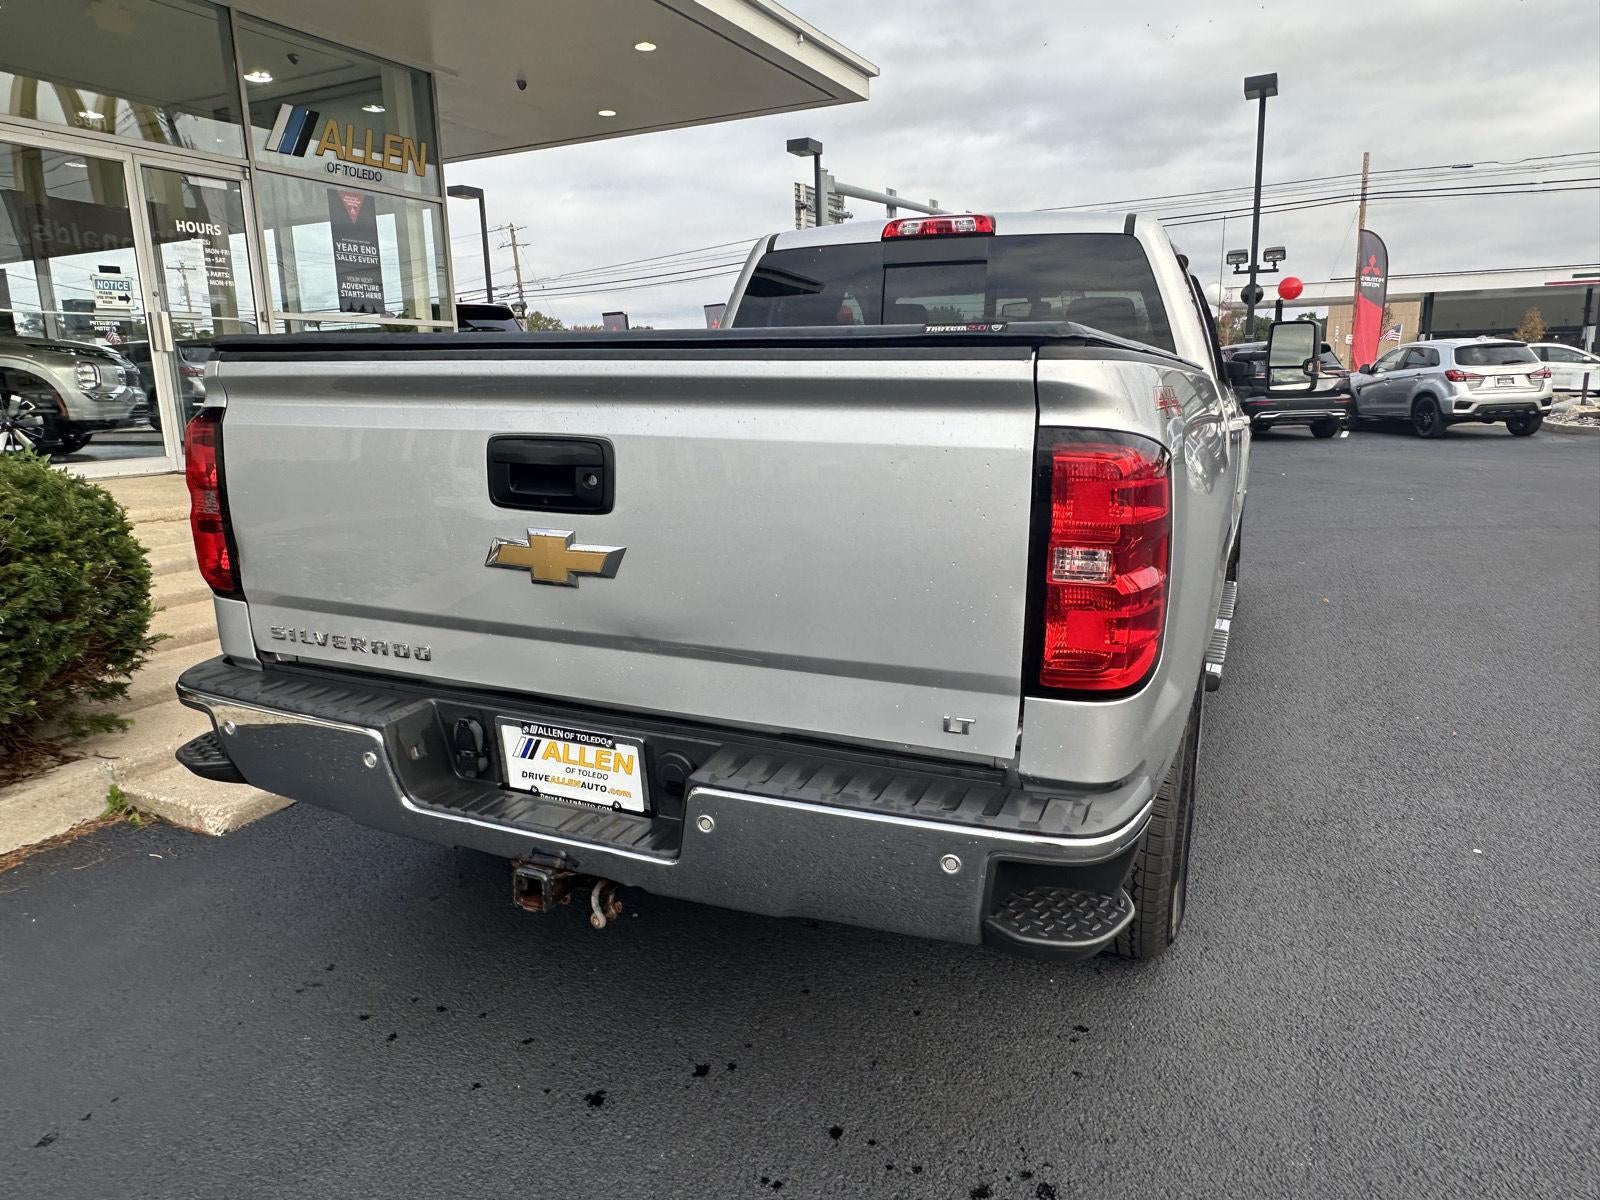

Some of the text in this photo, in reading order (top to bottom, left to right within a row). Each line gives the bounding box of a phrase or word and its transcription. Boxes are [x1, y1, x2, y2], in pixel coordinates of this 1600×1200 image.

[316, 119, 427, 177] ALLEN
[327, 162, 383, 182] OF TOLEDO
[175, 220, 222, 236] HOURS
[336, 242, 378, 255] YEAR END
[336, 253, 379, 265] SALES EVENT
[96, 280, 130, 291] NOTICE
[341, 282, 380, 292] ADVENTURE
[340, 289, 383, 300] STARTS HERE
[270, 624, 433, 662] SILVERADO
[942, 715, 977, 736] LT
[537, 726, 607, 746] ALLEN OF TOLEDO
[541, 741, 635, 776] ALLEN
[565, 766, 609, 781] OF TOLEDO
